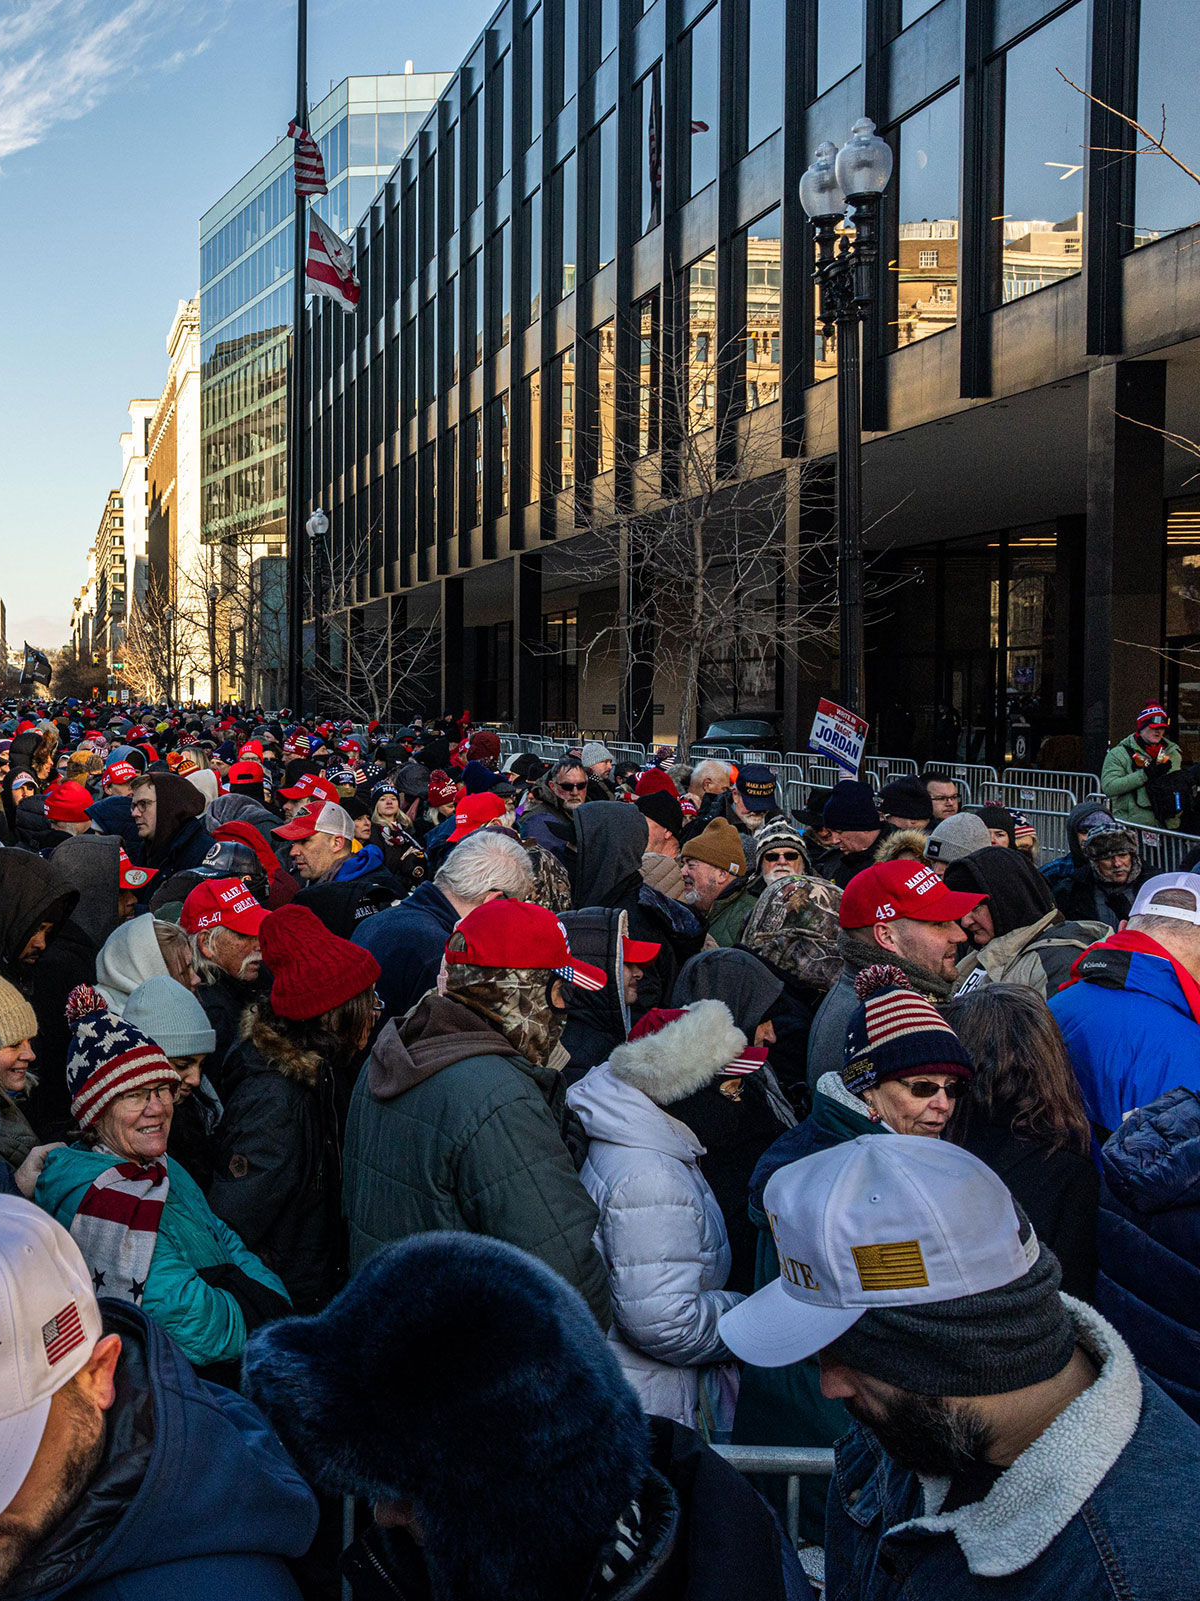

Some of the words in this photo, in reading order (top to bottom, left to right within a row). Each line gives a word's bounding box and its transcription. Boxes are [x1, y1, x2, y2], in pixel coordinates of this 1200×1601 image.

[834, 723, 852, 738] MAGIC
[816, 726, 860, 760] JORDAN
[904, 870, 925, 890] MAKE
[916, 875, 938, 895] GREAT
[220, 886, 241, 902] MAKE
[233, 897, 255, 914] GREAT
[875, 903, 896, 920] 45
[198, 911, 222, 927] 45-47
[1085, 961, 1108, 970] Columbia
